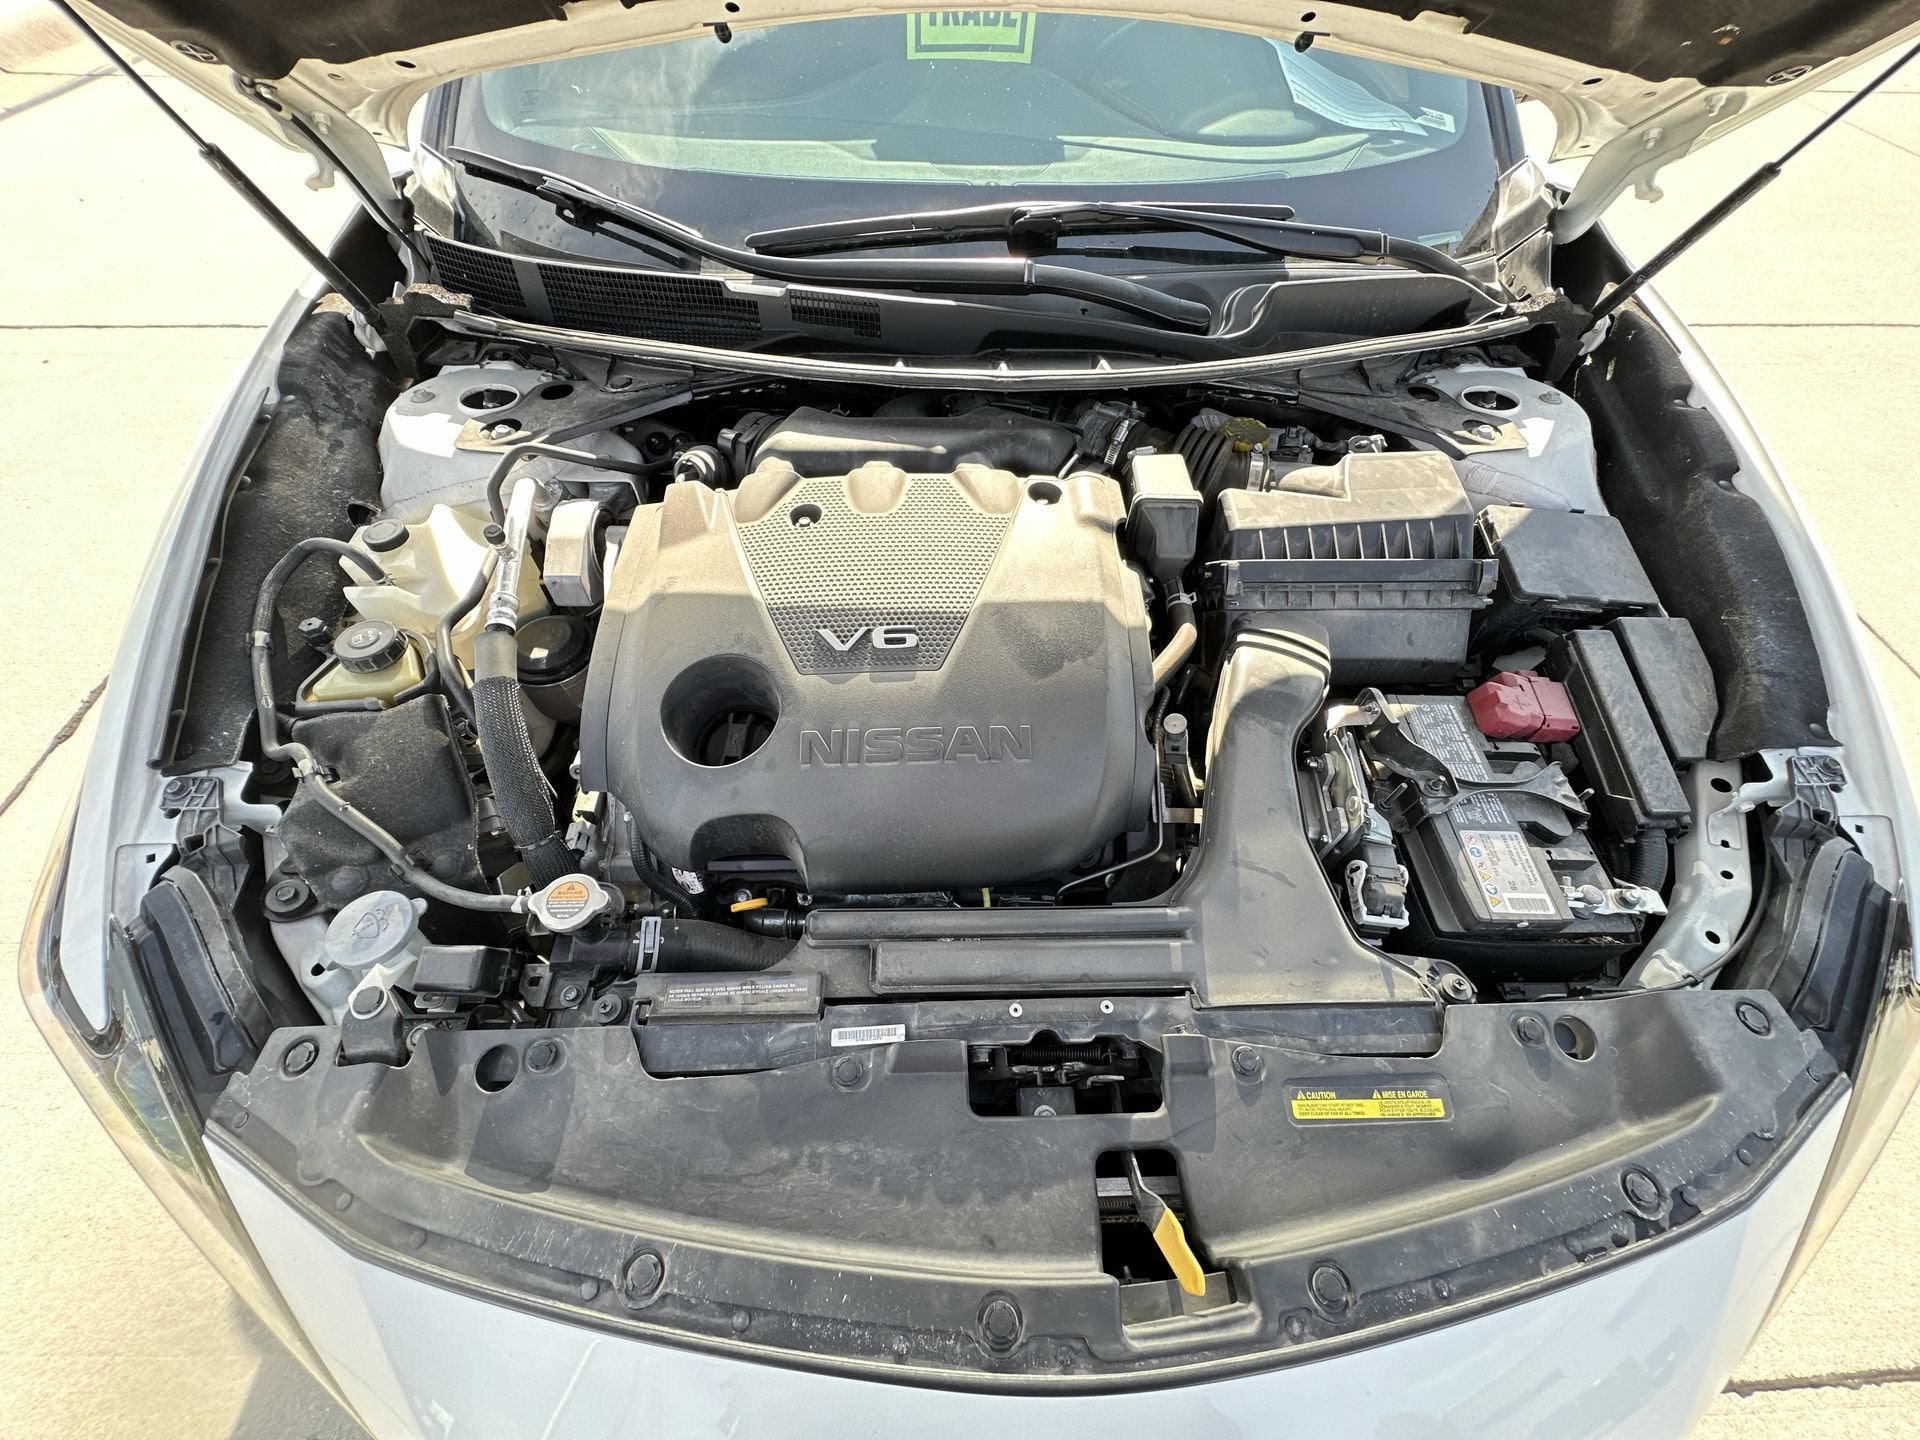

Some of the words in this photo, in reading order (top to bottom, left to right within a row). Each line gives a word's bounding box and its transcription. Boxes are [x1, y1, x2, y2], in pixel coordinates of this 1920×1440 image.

[815, 624, 919, 651] V6
[800, 725, 1032, 767] NISSAN
[1306, 1092, 1336, 1100] CAUTION
[1382, 1090, 1396, 1098] MISE
[1397, 1090, 1406, 1098] EN
[1406, 1090, 1428, 1098] GARDE
